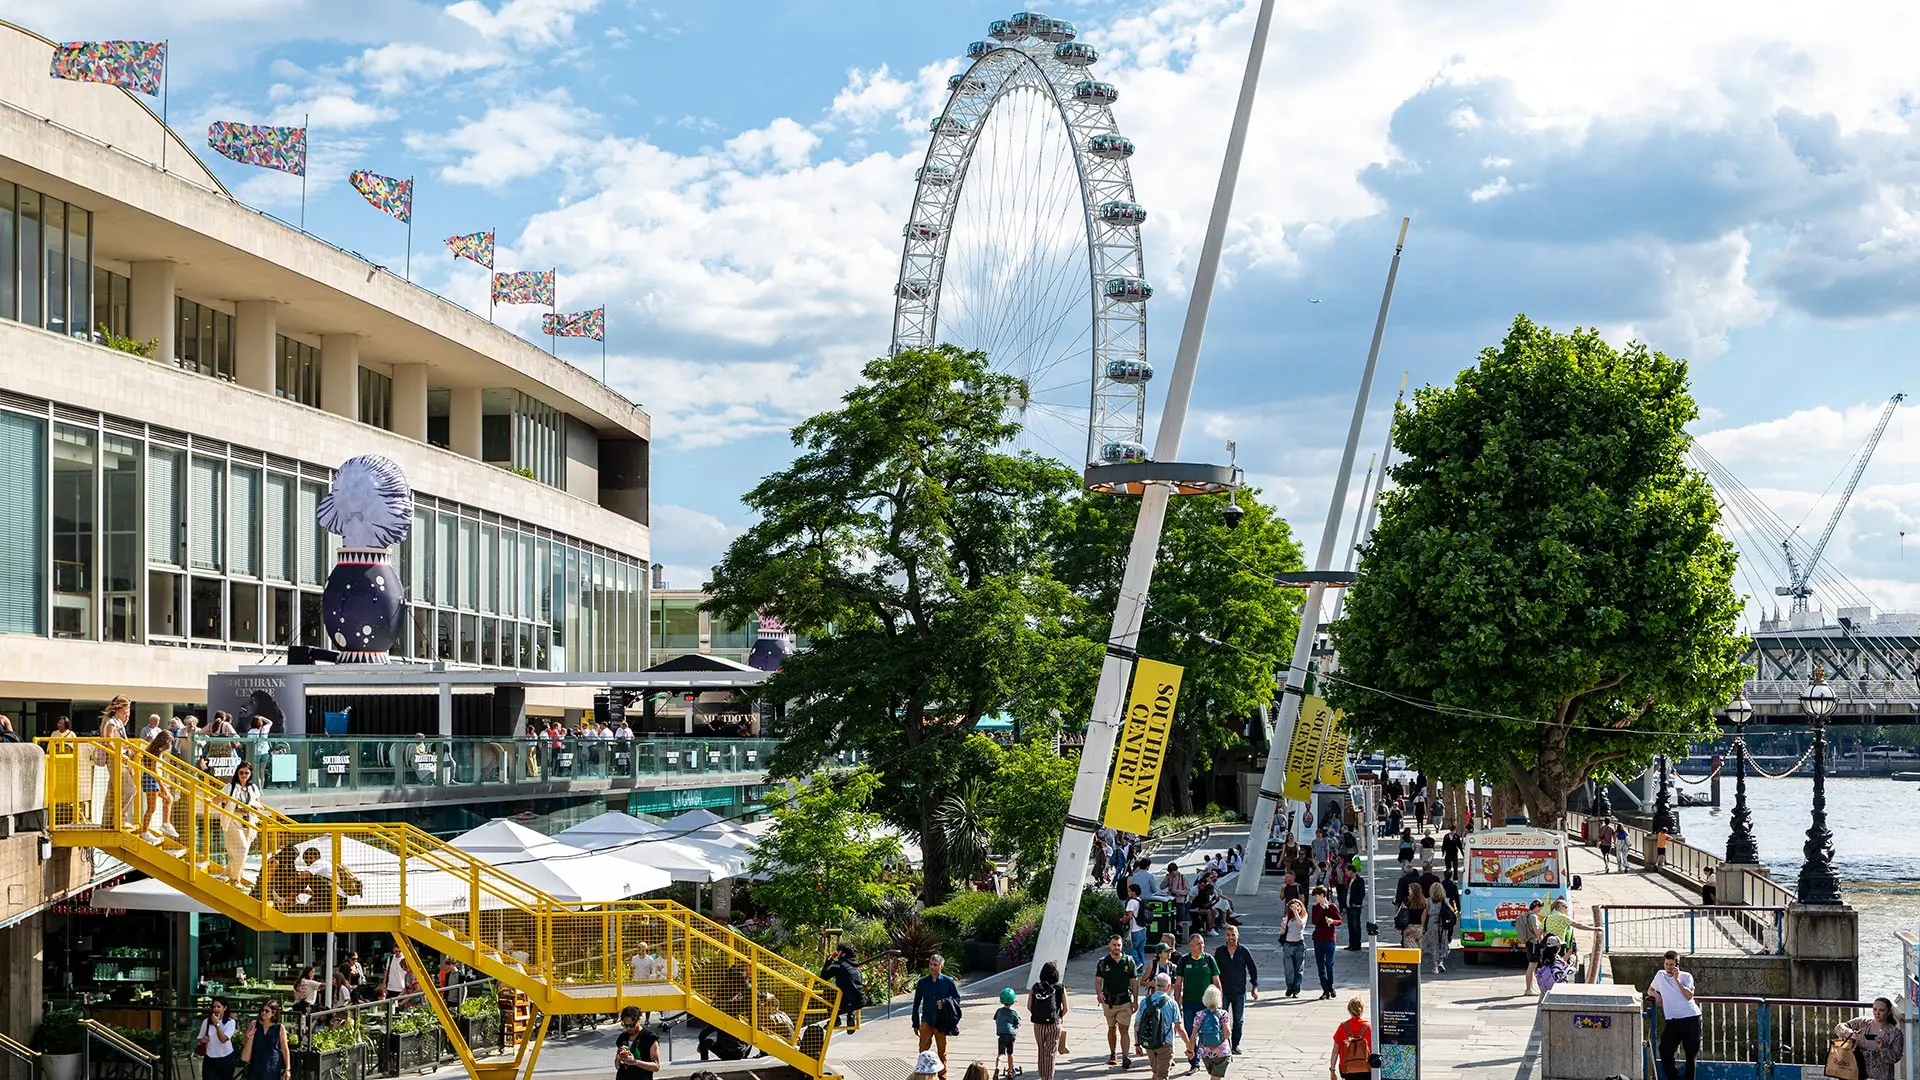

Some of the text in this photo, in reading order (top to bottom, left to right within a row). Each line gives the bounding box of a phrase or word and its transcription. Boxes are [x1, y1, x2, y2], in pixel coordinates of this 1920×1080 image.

[703, 713, 758, 724] METDOWN
[1117, 704, 1149, 787] CENTRE
[1131, 683, 1174, 815] SOUTHBANK
[1290, 721, 1311, 773] CENTRE
[1299, 709, 1327, 790] SOUTHBANK
[1326, 734, 1340, 765] ENTRE
[1481, 836, 1546, 846] SUPER SOFT ICE
